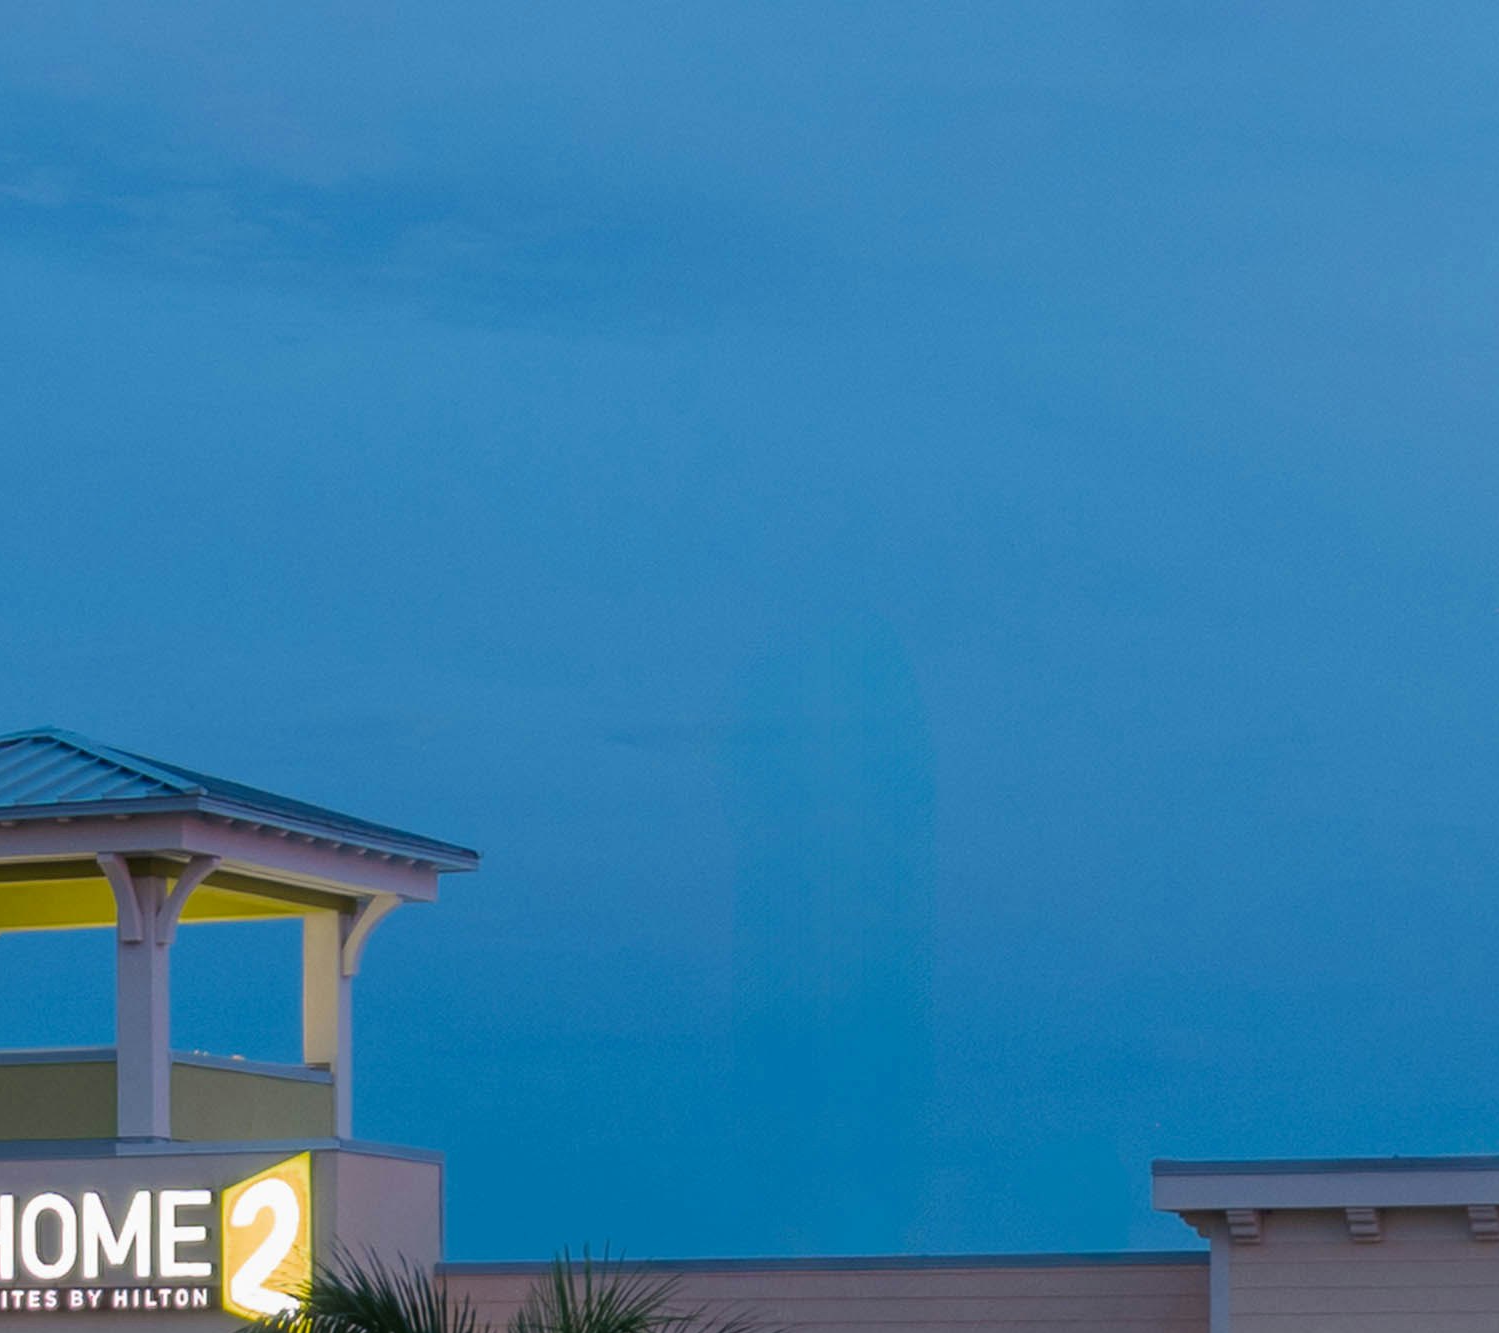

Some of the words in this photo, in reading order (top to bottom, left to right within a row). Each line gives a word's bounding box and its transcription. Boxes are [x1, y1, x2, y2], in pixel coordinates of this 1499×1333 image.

[230, 1177, 301, 1319] 2
[69, 1289, 102, 1309] BY
[112, 1287, 208, 1308] HILTON
